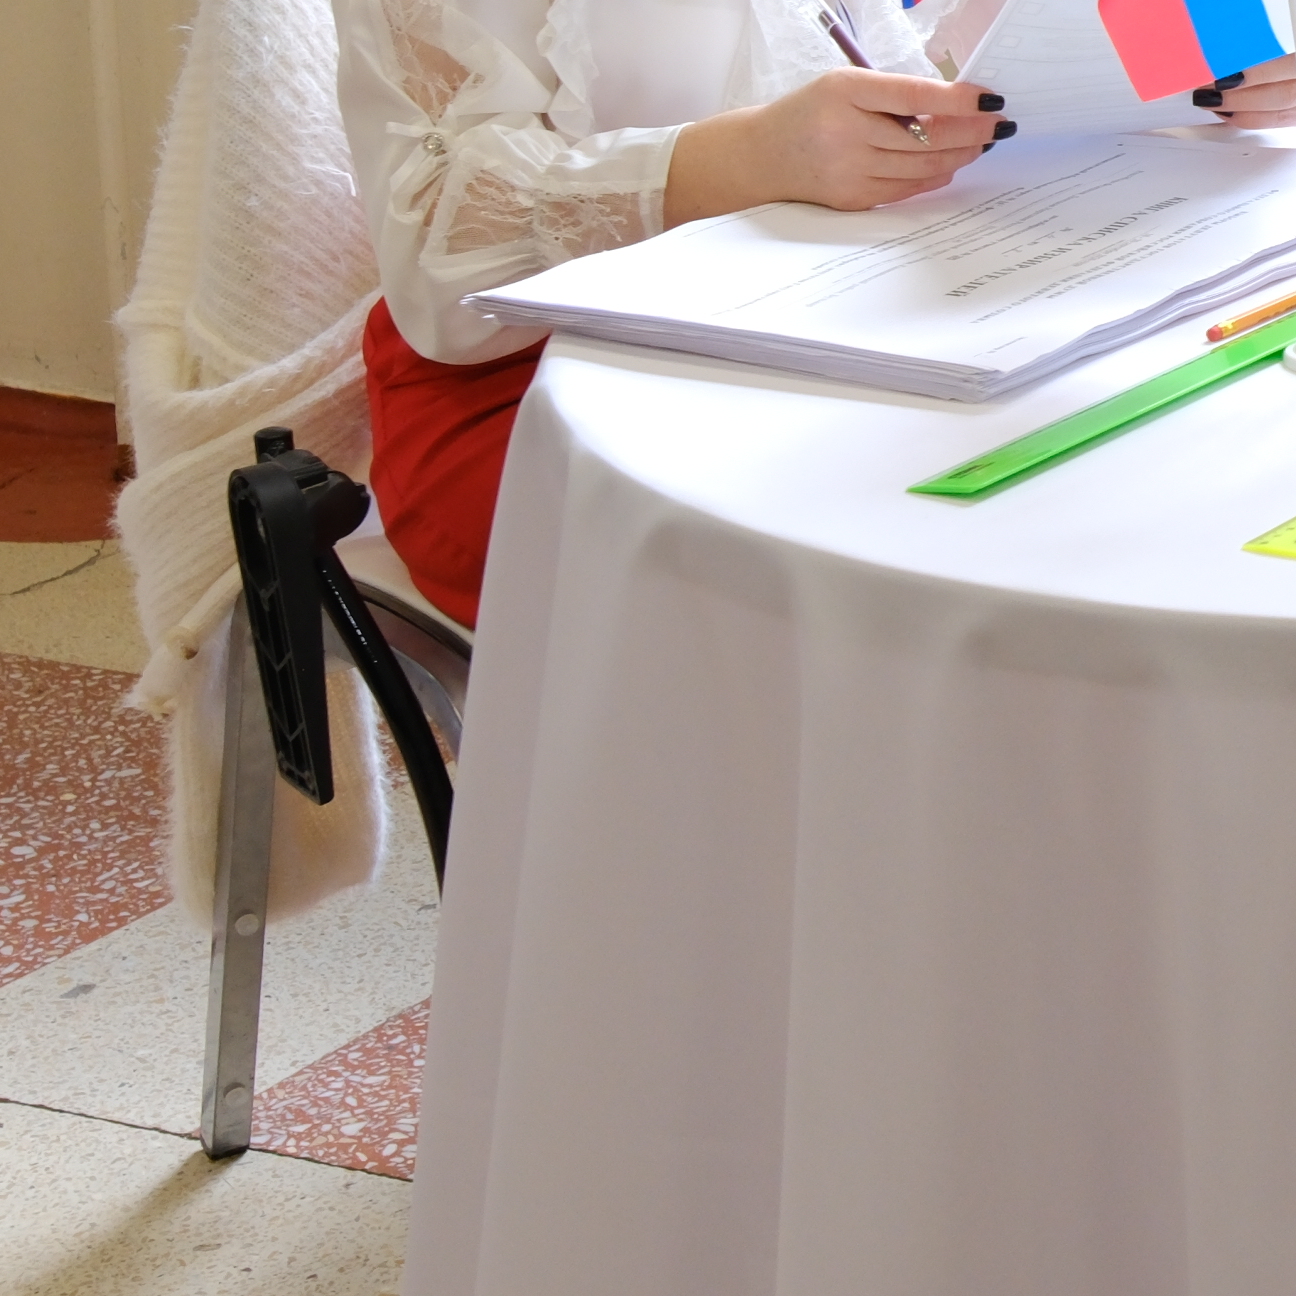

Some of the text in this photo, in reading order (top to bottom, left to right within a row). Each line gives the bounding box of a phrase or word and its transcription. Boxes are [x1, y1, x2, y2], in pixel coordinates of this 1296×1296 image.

[1129, 196, 1192, 216] КНИГА
[1061, 216, 1146, 246] СПИСКА
[940, 246, 1075, 297] ИЗБИРАТЕЛЕЙ
